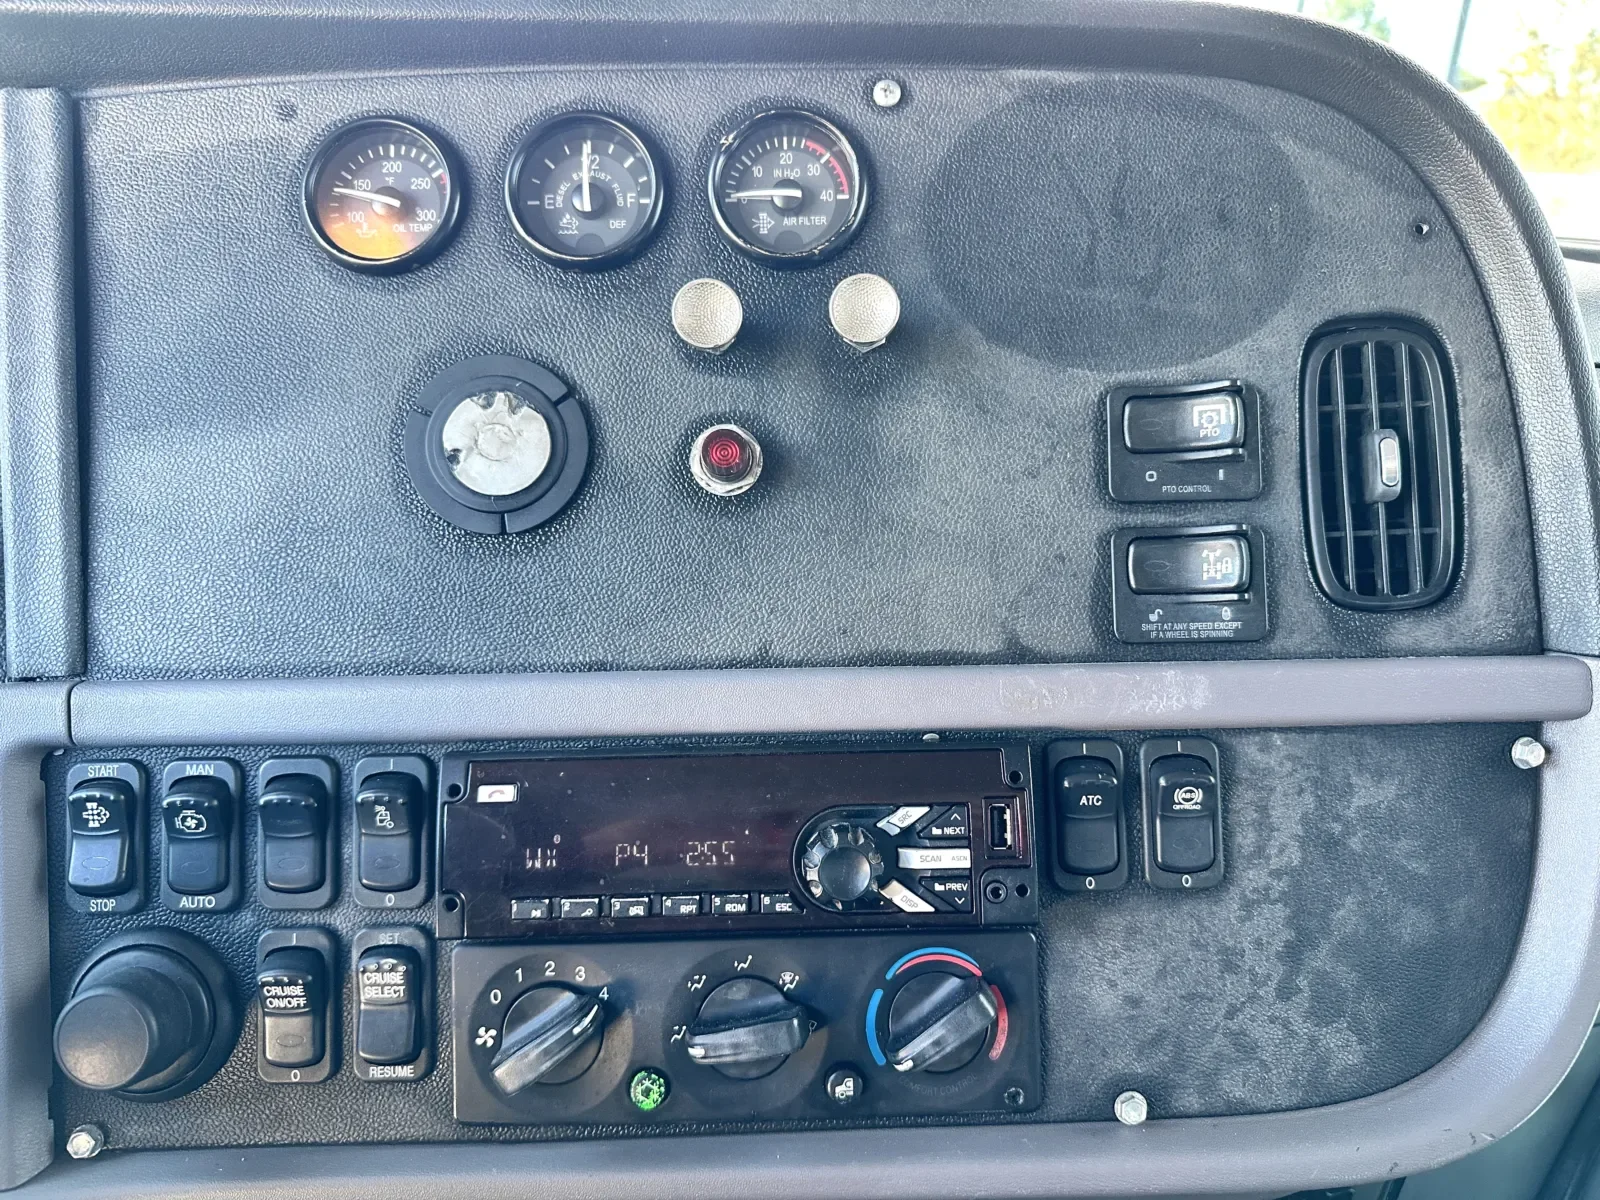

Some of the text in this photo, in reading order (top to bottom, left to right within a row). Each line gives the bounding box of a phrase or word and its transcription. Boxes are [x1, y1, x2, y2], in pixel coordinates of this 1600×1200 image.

[779, 152, 793, 165] 20
[382, 161, 402, 173] 200
[752, 167, 763, 178] 10
[807, 164, 820, 176] 30
[571, 170, 612, 182] EXAUST
[773, 169, 783, 178] IN
[353, 179, 371, 190] 150
[411, 178, 431, 190] 250
[544, 194, 555, 209] E
[626, 193, 636, 208] F
[819, 190, 833, 202] 40
[347, 211, 365, 223] 100
[416, 209, 436, 222] 300
[783, 216, 827, 226] AIR FILTER
[392, 223, 433, 233] OIL TEMP
[609, 220, 627, 229] DEF
[1200, 428, 1220, 437] PTO
[1162, 484, 1212, 493] PTO CONTROL
[1141, 621, 1243, 631] SHIFT AT ANY SPEED EXCEPT
[1150, 629, 1234, 639] IF A WHEEL IS SPINNING
[87, 764, 120, 777] START
[186, 764, 214, 776] MAN
[1079, 795, 1102, 806] ATC
[898, 812, 912, 825] SRC
[943, 826, 965, 835] NEXT
[526, 848, 557, 869] WX
[615, 844, 648, 866] P4
[919, 854, 942, 863] SCAN
[946, 882, 968, 891] PREV
[89, 899, 116, 912] STOP
[179, 896, 216, 908] AUTO
[563, 902, 570, 911] 2
[613, 902, 620, 910] 3
[665, 899, 671, 908] 4
[763, 897, 770, 905] 6
[775, 902, 792, 911] ESC
[900, 894, 919, 909] DISP
[680, 905, 696, 914] RPT
[379, 933, 399, 944] SET
[544, 961, 556, 976] 2
[575, 966, 586, 981] 3
[364, 972, 404, 984] CRUISE
[515, 968, 523, 983] 1
[263, 986, 305, 996] CRUISE
[364, 986, 405, 998] SELECT
[490, 989, 502, 1004] 0
[599, 986, 609, 1000] 4
[266, 998, 306, 1008] ON/OFF
[369, 1066, 414, 1078] RESUME
